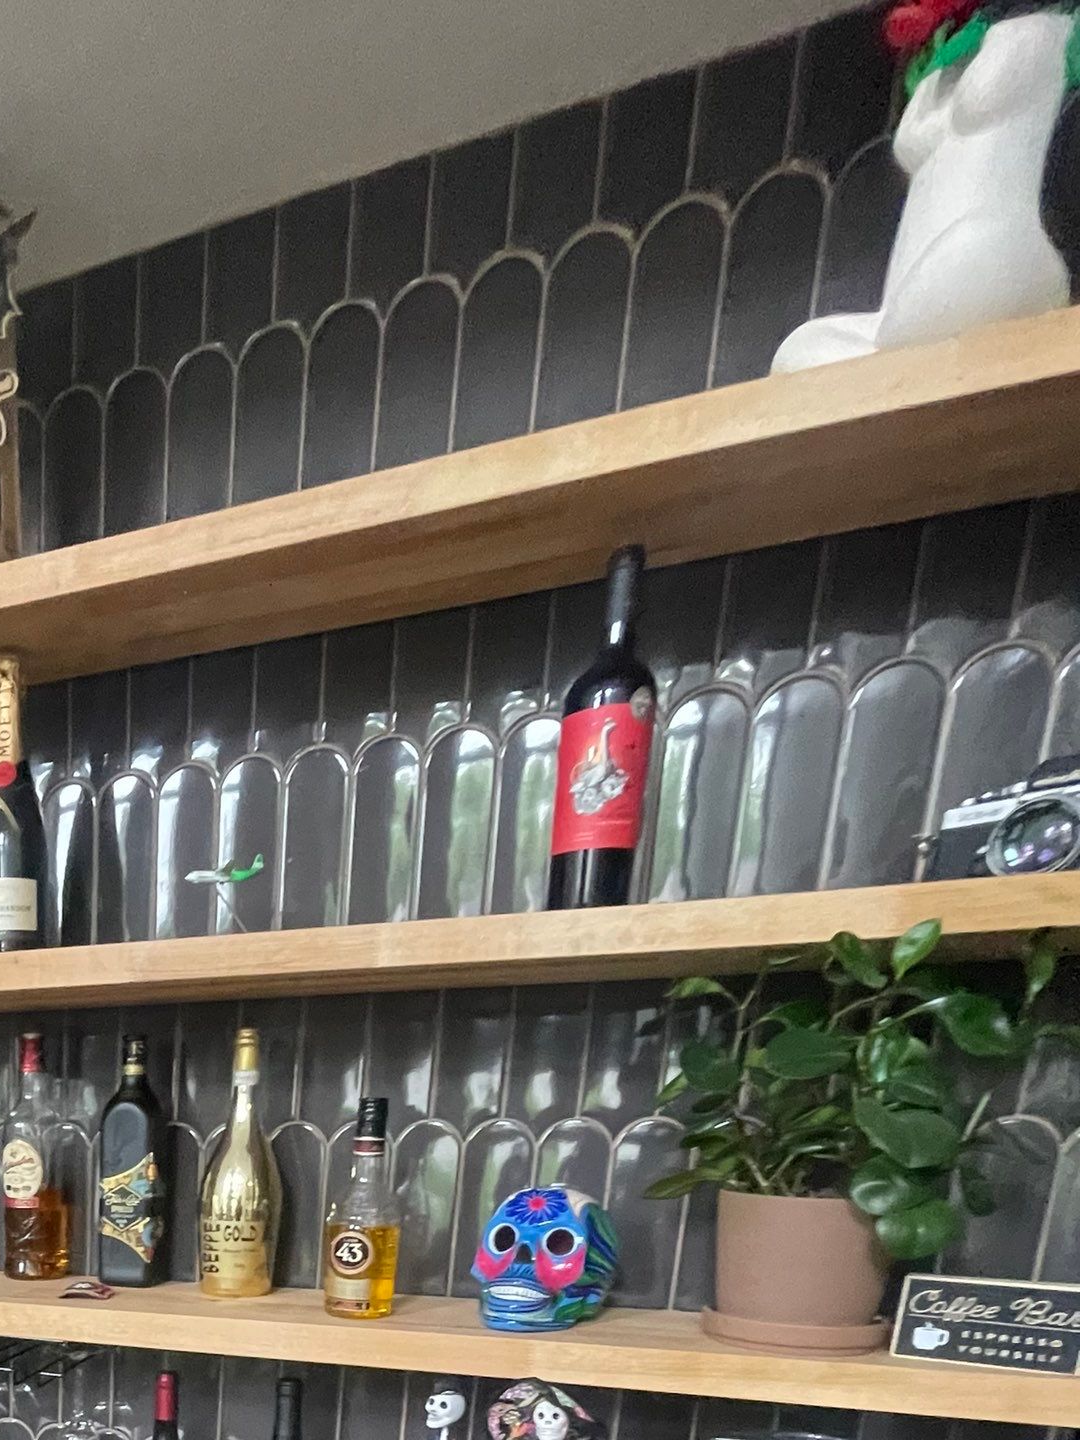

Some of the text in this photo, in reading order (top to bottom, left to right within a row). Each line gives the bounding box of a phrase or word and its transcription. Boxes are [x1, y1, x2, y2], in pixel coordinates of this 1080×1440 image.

[203, 1222, 220, 1273] BEPPE
[335, 1242, 363, 1262] 43
[909, 1288, 1001, 1323] Coffee
